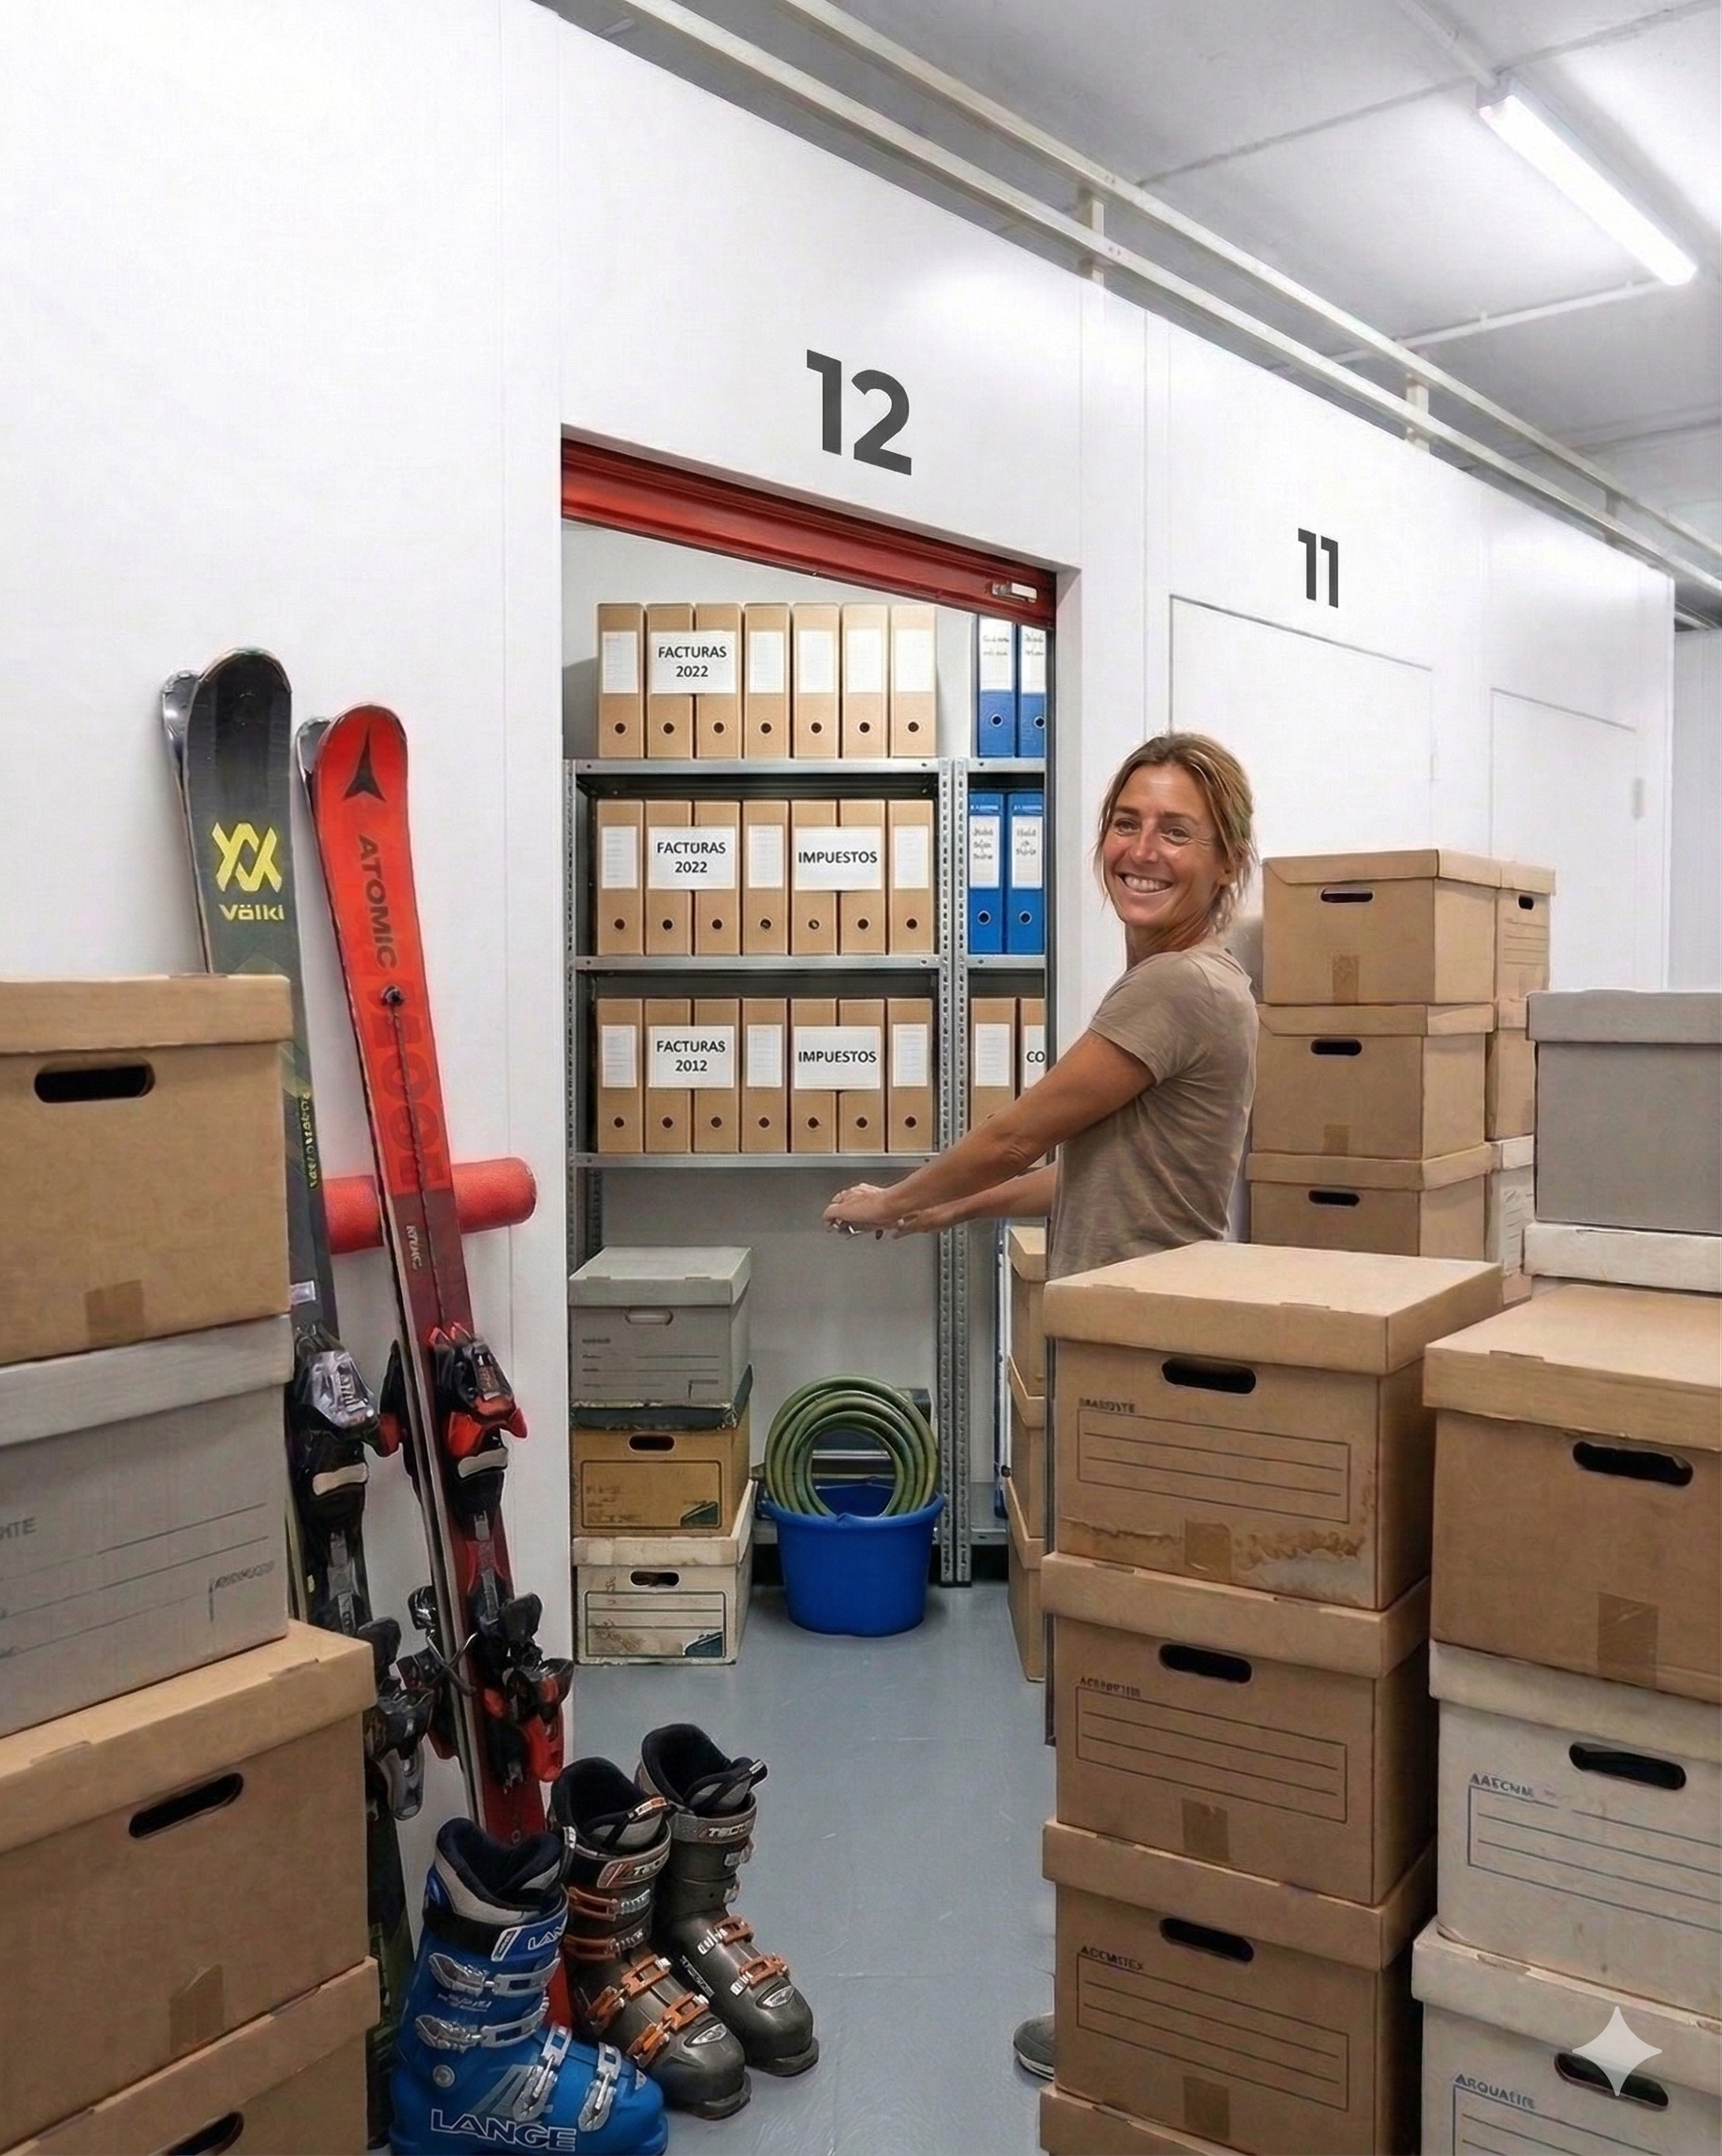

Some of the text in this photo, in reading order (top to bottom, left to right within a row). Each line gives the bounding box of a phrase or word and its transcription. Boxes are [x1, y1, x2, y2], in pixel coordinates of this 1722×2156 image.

[806, 348, 912, 476] 12
[1297, 527, 1339, 609] 11
[658, 646, 727, 658] FACTURAS
[676, 665, 708, 677] 2022
[656, 842, 726, 854] FACTURAS
[798, 851, 878, 864] IMPUESTOS
[674, 861, 708, 873] 2022
[358, 833, 398, 969] ATOMIC
[656, 1040, 726, 1053] FACTURAS
[798, 1050, 877, 1063] IMPUESTOS
[1026, 1050, 1045, 1063] CO
[675, 1059, 708, 1072] 2012
[430, 2107, 577, 2152] LANGE
